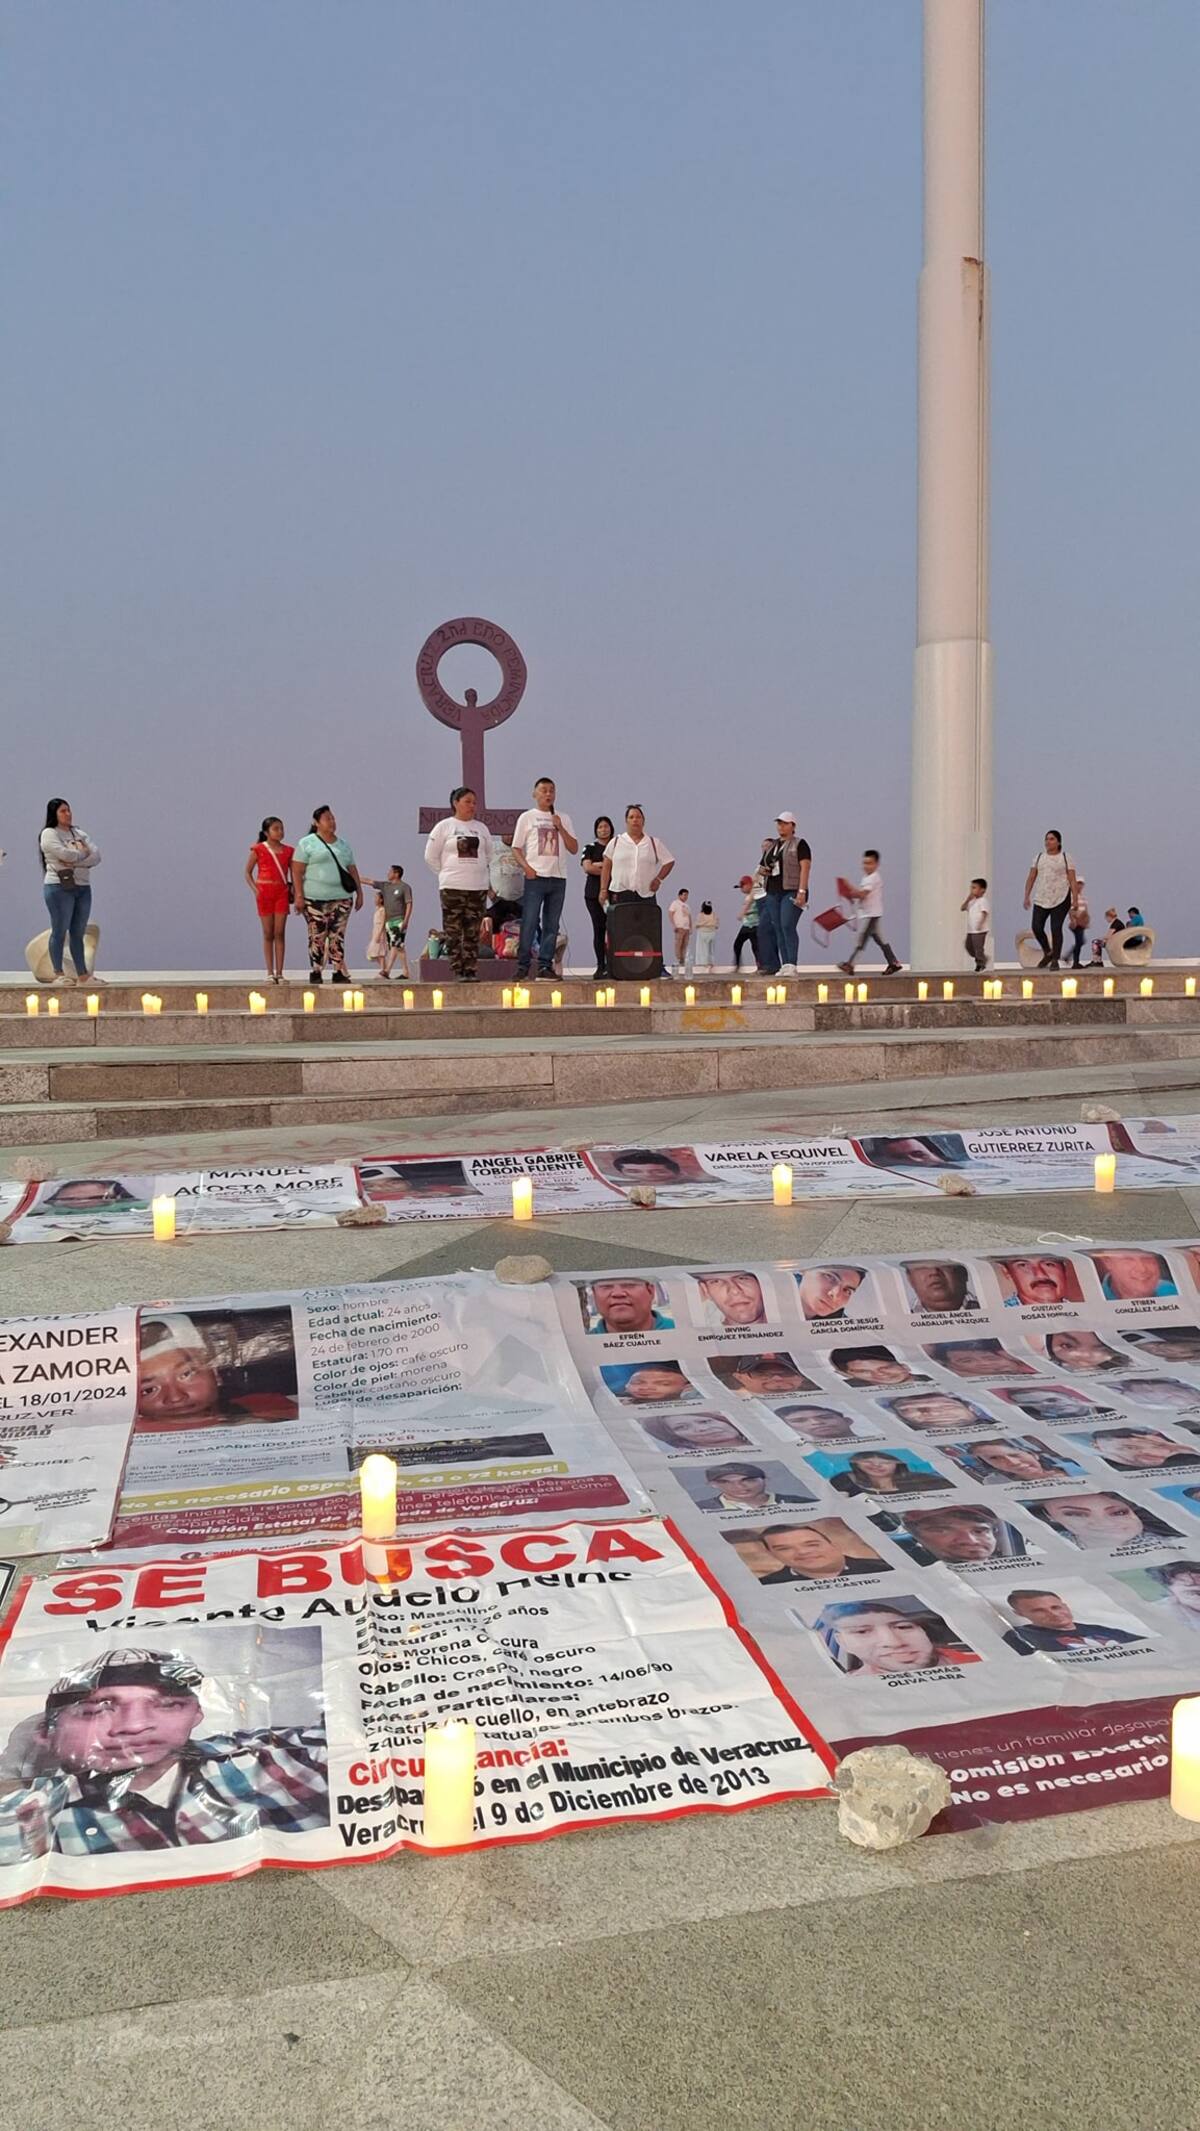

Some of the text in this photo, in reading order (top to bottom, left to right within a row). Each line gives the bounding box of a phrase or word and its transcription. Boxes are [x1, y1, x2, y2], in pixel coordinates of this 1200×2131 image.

[1015, 1125, 1078, 1137] ANTONIO
[704, 1147, 849, 1162] VARELA ESQUIVEL
[968, 1140, 1096, 1154] GUTIERREZ ZURITA
[471, 1156, 521, 1169] ANGEL
[209, 1168, 311, 1179] MANUEL
[306, 1302, 340, 1314] Sexo:
[308, 1301, 431, 1328] Edad actual: 24 años
[1031, 1304, 1064, 1312] GUSTAVO
[1115, 1305, 1152, 1314] GONZÁLEZ
[309, 1311, 442, 1343] Fecha de nacimiento:
[810, 1324, 885, 1335] GARCÍA DOMÍNGUEZ
[811, 1319, 843, 1328] IGNACIO
[844, 1318, 855, 1326] DE
[911, 1316, 990, 1327] GUADALUPE VÁZQUEZ
[311, 1322, 440, 1357] 24 de febrero de 2000
[603, 1338, 662, 1349] BÁEZ CUAUTLE
[619, 1332, 645, 1340] EFRÉN
[697, 1330, 785, 1342] ENRÍQUEZ FERNÁNDEZ
[312, 1352, 369, 1369] Estatura:
[396, 1345, 409, 1354] m
[313, 1341, 469, 1382] Color de ojos: café oscuro
[12, 1356, 131, 1384] ZAMORA
[314, 1360, 449, 1393] Color de piel: morena
[369, 1379, 418, 1394] castaño
[421, 1369, 462, 1386] oscuro
[20, 1386, 128, 1407] 18/01/2024
[356, 1394, 374, 1404] de
[377, 1382, 463, 1404] desaparición:
[154, 1498, 178, 1507] es
[184, 1484, 291, 1505] necesario
[496, 1464, 558, 1478] horas!
[184, 1506, 234, 1519] iniciar
[240, 1504, 253, 1513] el
[260, 1500, 318, 1514] reporte
[165, 1523, 248, 1536] Comisión
[252, 1517, 316, 1531] Estatal
[320, 1514, 342, 1524] de
[435, 1506, 456, 1514] de
[983, 1555, 1033, 1566] ANTONIO
[990, 1560, 1046, 1573] MONTOYA
[43, 1529, 665, 1616] SE BUSCA
[813, 1576, 850, 1586] DAVID
[794, 1578, 881, 1593] LÓPEZ CASTRO
[408, 1616, 478, 1633] actual:
[507, 1604, 550, 1616] años
[410, 1604, 499, 1620] Masculino
[403, 1633, 540, 1658] Morena Ocura
[1067, 1645, 1124, 1658] RICARDO
[1103, 1646, 1156, 1661] HUERTA
[358, 1660, 411, 1677] Ojos:
[416, 1651, 488, 1667] Chicos,
[533, 1645, 597, 1664] oscuro
[359, 1661, 583, 1696] Cabello: Crespo, negro
[880, 1665, 962, 1681] JOSÉ TOMÁS
[888, 1672, 966, 1689] OLIVA LARA
[361, 1662, 673, 1711] Fecha de nacimiento: 14/06/90
[475, 1691, 671, 1727] cuello, en antebrazo
[667, 1703, 740, 1720] brazos.
[934, 1725, 1097, 1760] tienes un familiar
[491, 1736, 816, 1794] en el Municipio de Veracruz,
[951, 1754, 1169, 1806] No es necesario
[491, 1766, 771, 1826] 9 de Diciembre de 2013
